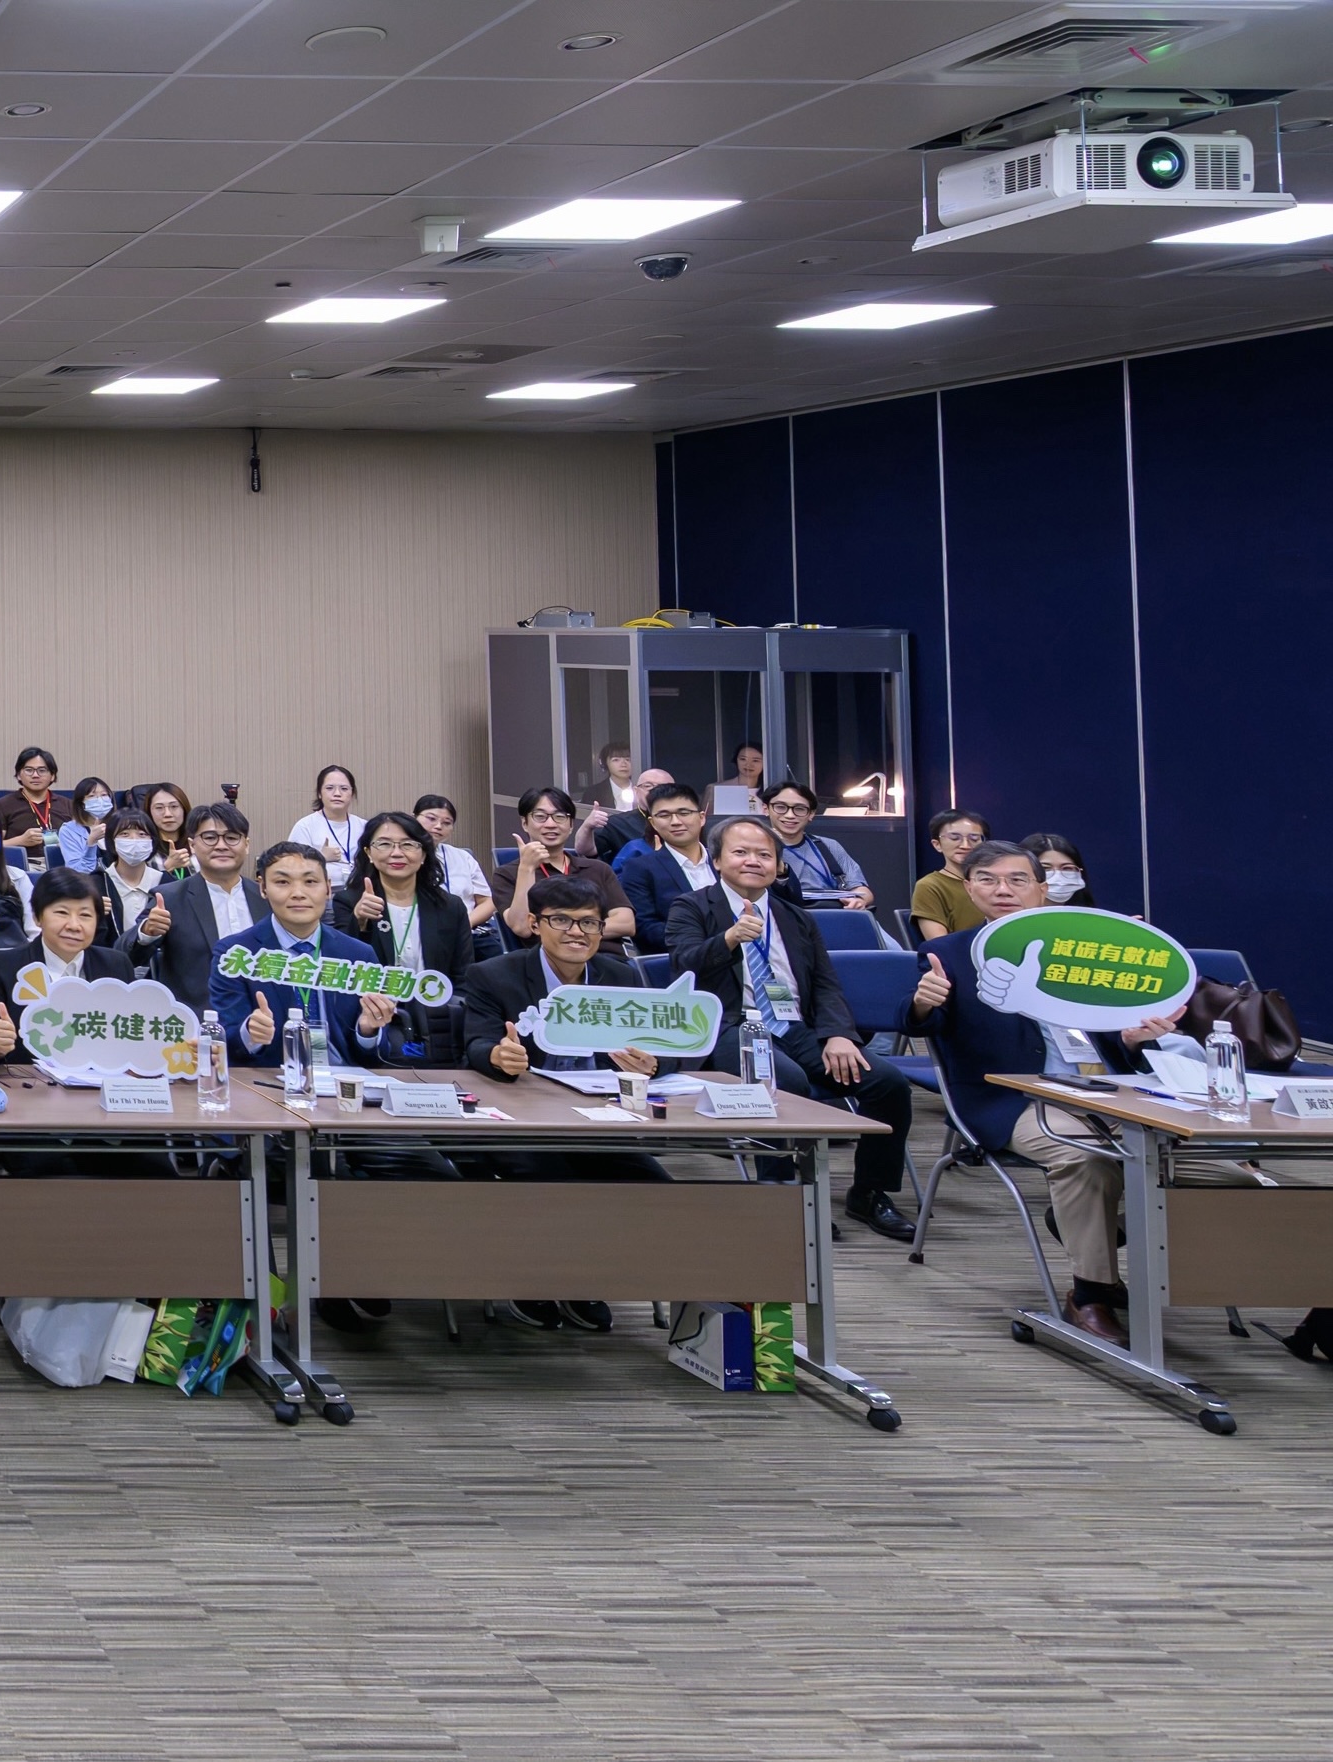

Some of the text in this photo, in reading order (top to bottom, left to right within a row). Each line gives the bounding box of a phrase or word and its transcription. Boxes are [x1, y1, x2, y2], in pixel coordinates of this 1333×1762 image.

[1050, 937, 1171, 969] 減碳有數據
[221, 947, 417, 998] 永續金融推動
[1043, 963, 1163, 994] 金融更給力
[71, 1011, 186, 1043] 碳健檢
[543, 996, 688, 1030] 永續金融
